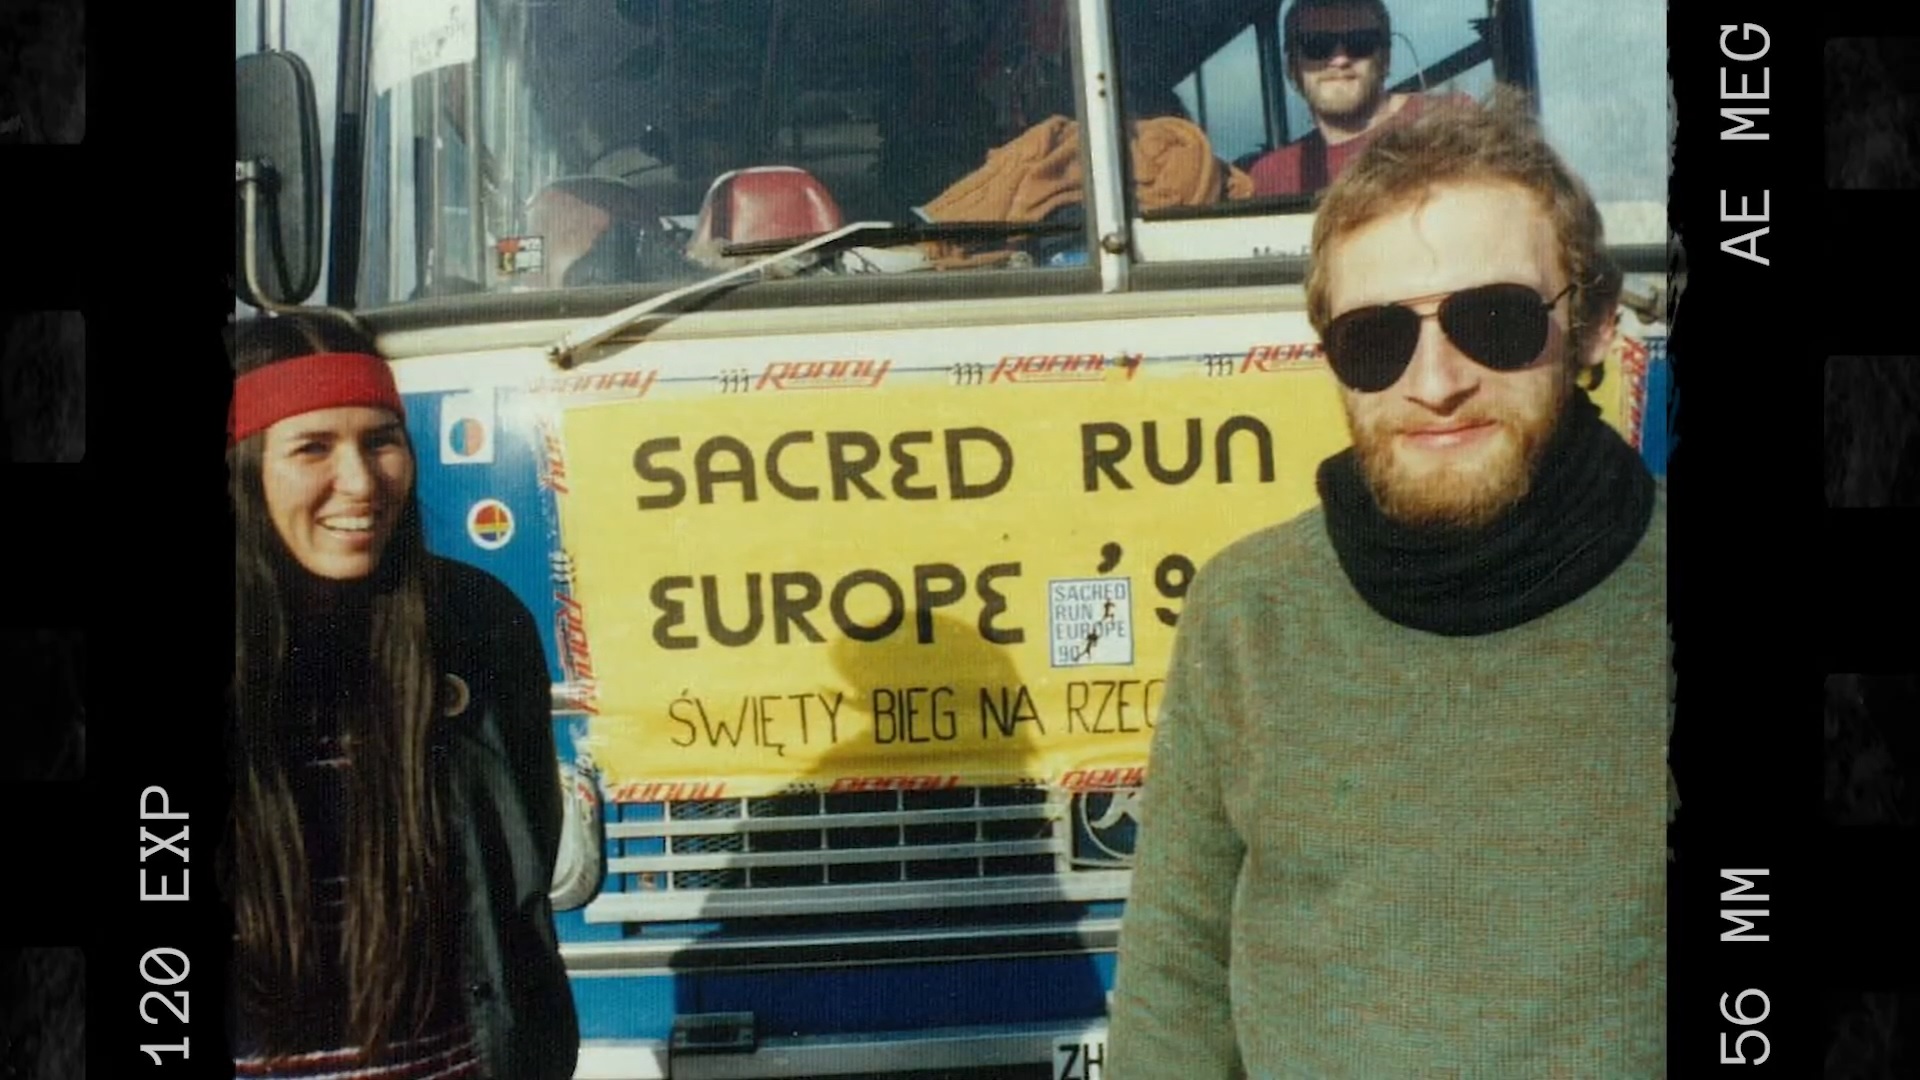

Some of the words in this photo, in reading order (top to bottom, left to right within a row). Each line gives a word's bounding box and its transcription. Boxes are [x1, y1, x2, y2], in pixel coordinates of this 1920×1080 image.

[633, 426, 1014, 511] SACRED
[1082, 414, 1276, 495] RUN
[650, 562, 1024, 650] EUROPE
[1053, 583, 1126, 602] SACRED
[1055, 603, 1093, 621] RUN
[1056, 620, 1127, 640] EUROPE
[1058, 645, 1080, 663] 90
[668, 689, 845, 757] ŚWIĘTY
[872, 686, 958, 745] BIEG
[980, 683, 1047, 741] NA
[1058, 1043, 1104, 1080] ZH
